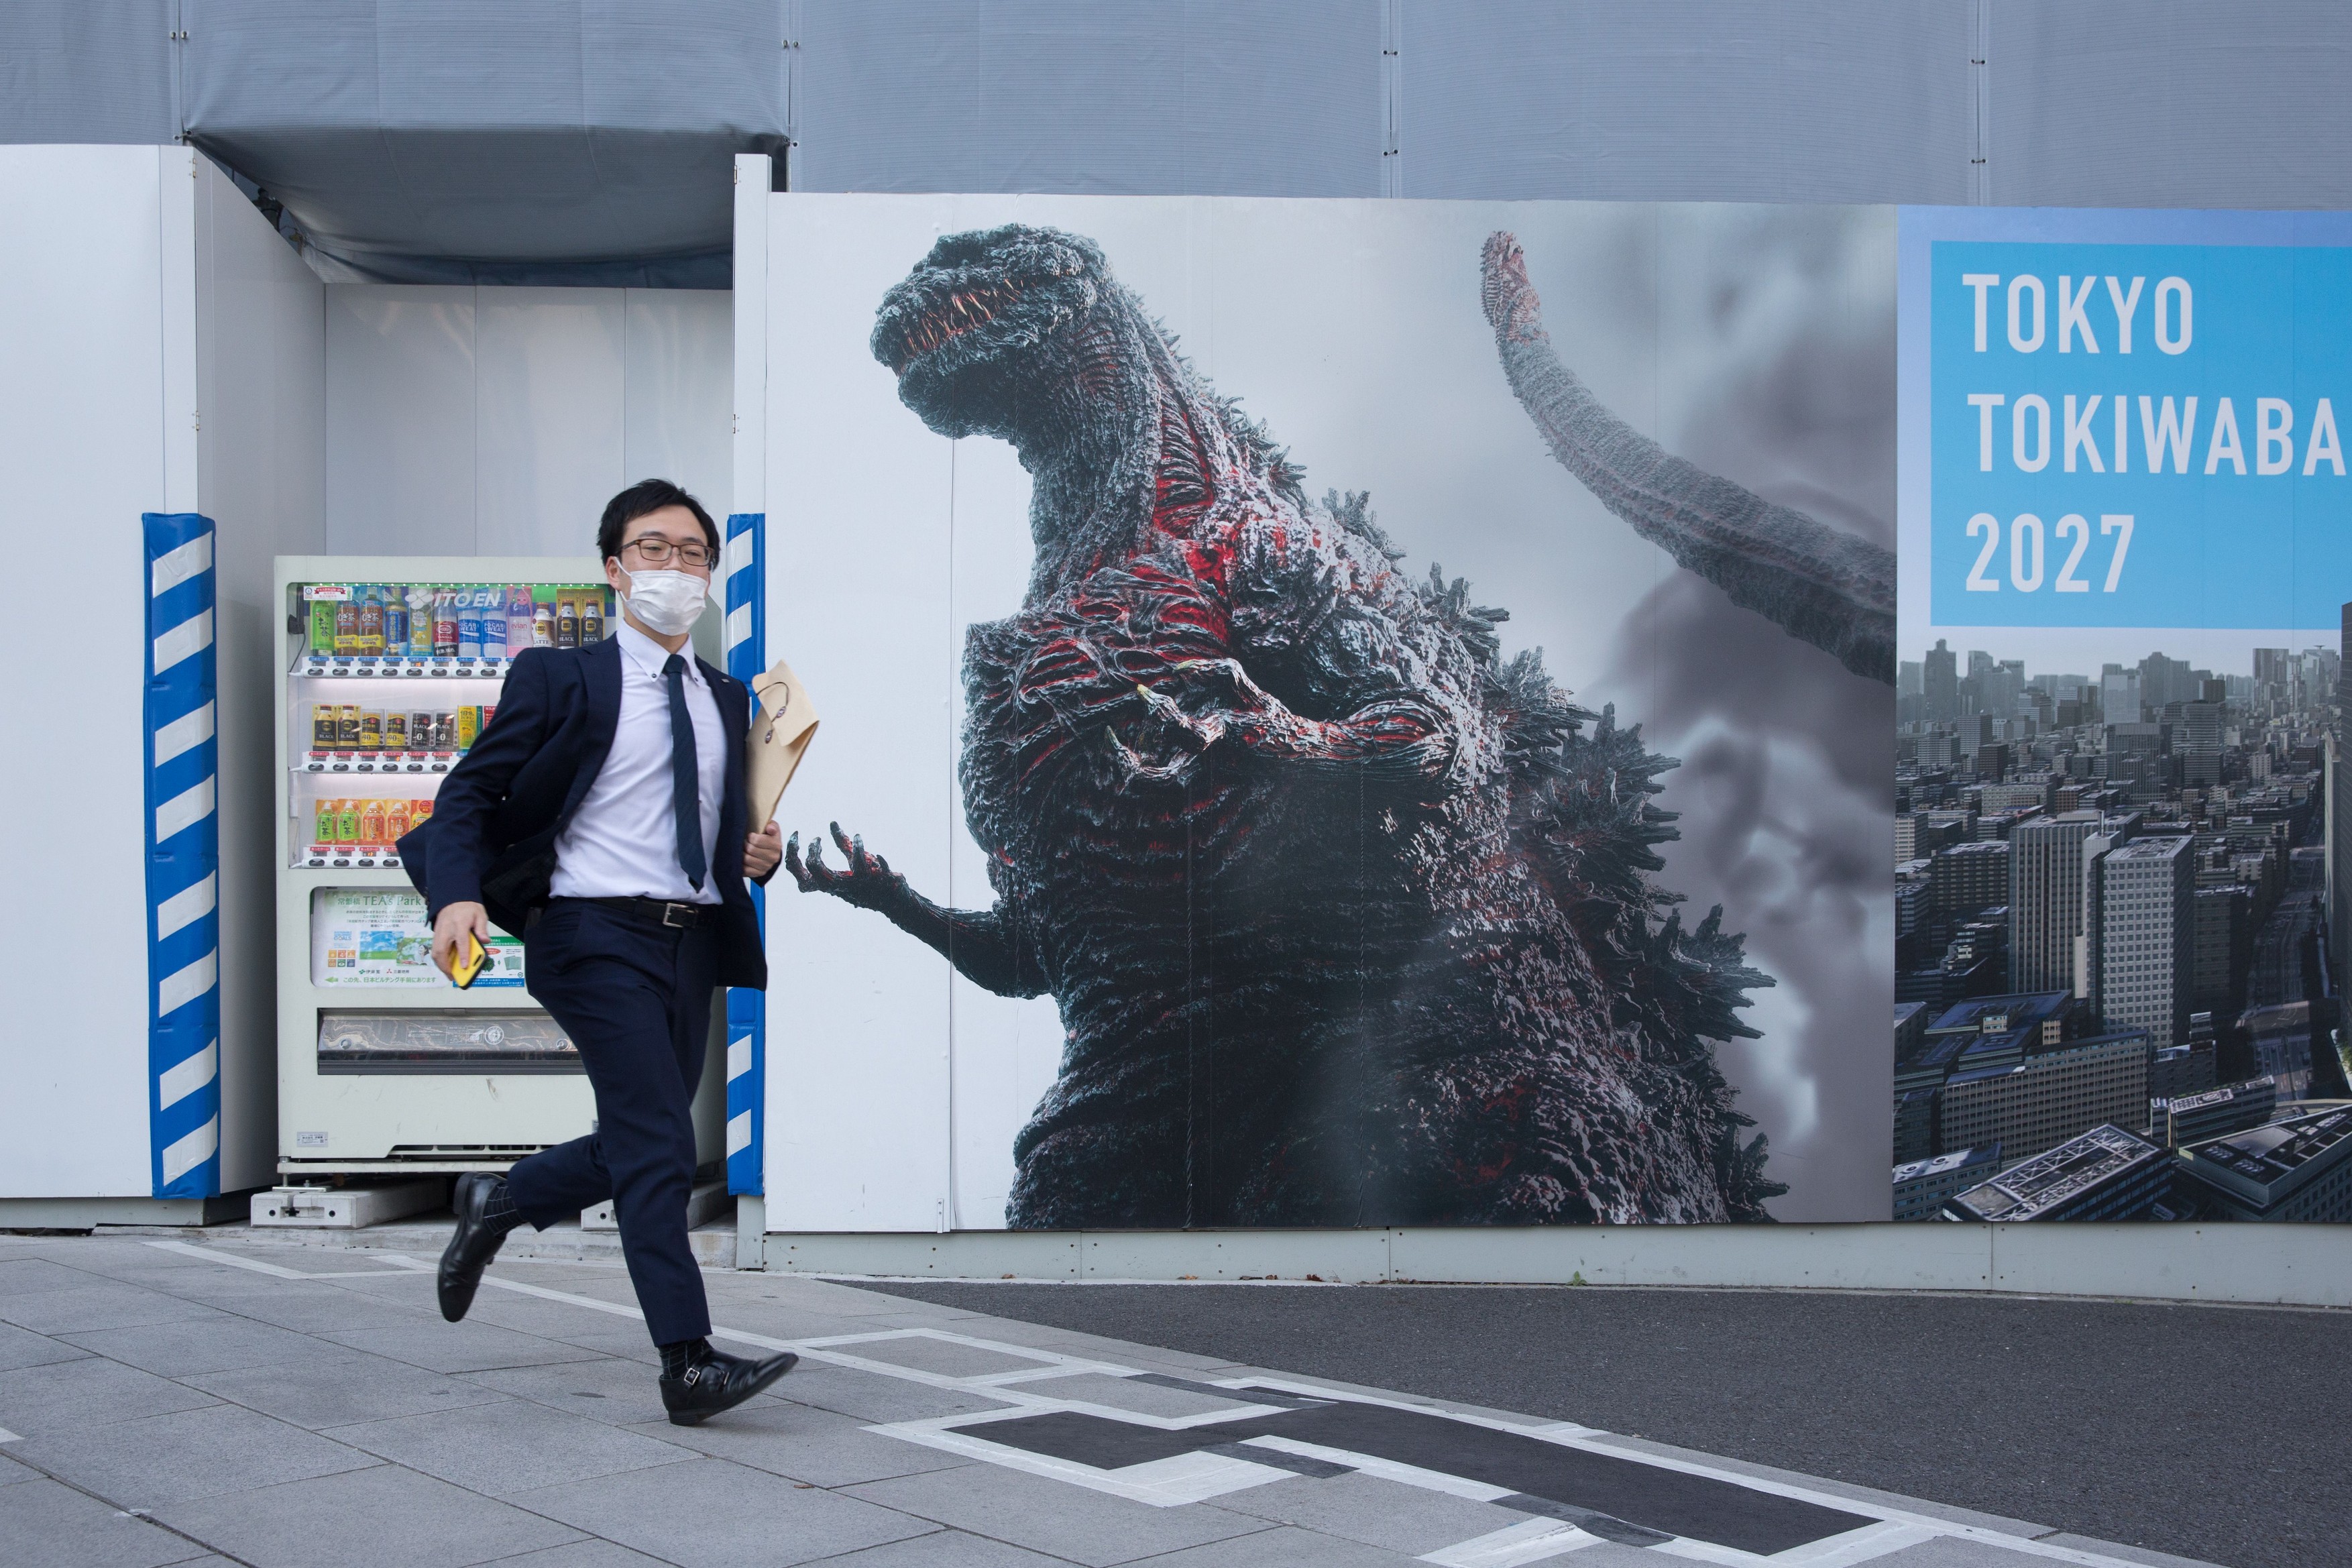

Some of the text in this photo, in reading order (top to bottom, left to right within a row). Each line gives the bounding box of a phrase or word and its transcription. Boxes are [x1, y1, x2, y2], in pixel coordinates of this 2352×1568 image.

[1962, 274, 2193, 355] TOKYO
[1967, 393, 2347, 477] TOKIWABA
[1966, 512, 2135, 593] 2027
[434, 593, 501, 607] ITO EN
[363, 895, 393, 905] TEA's
[397, 895, 421, 905] Park
